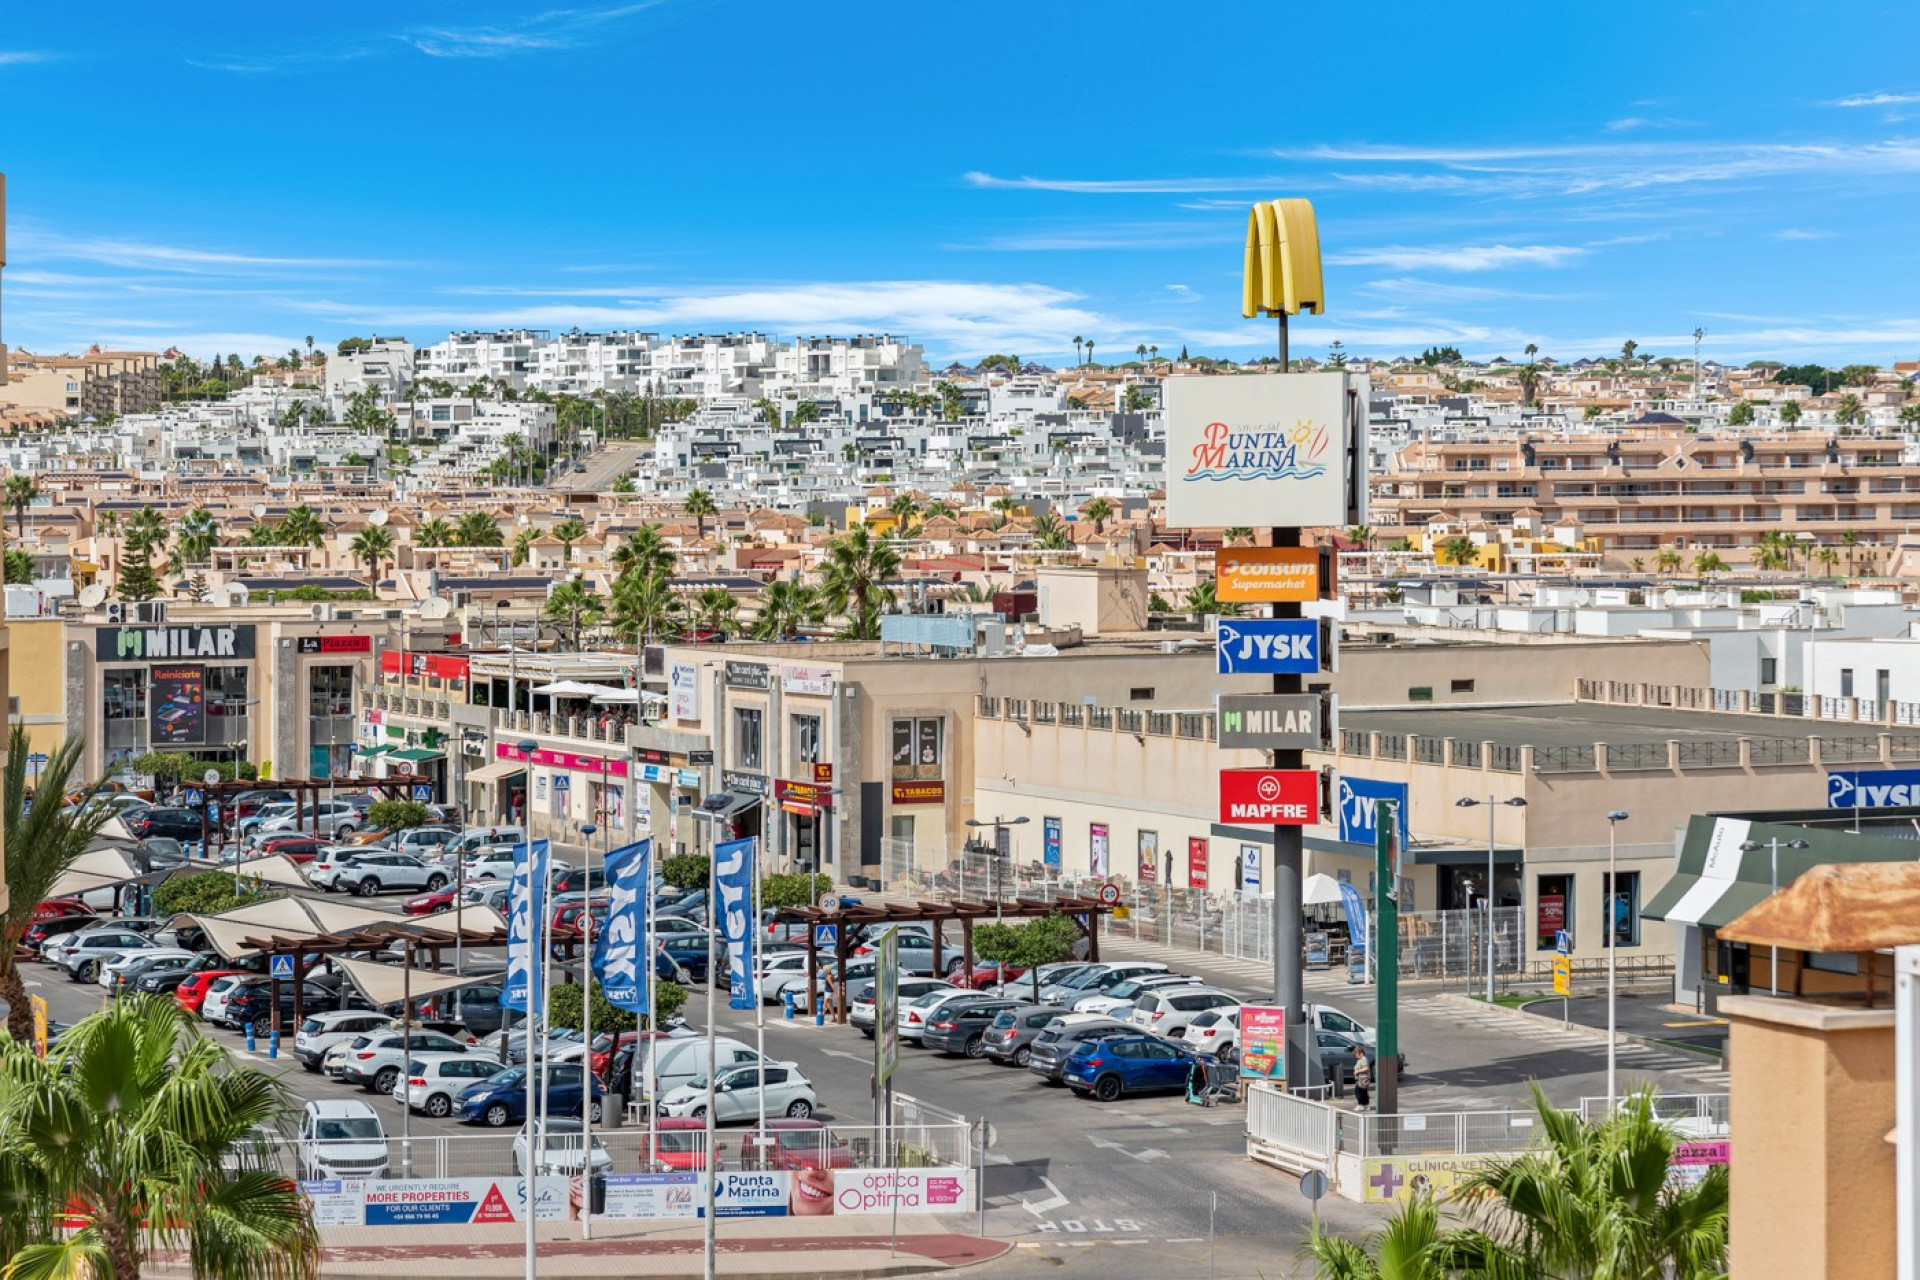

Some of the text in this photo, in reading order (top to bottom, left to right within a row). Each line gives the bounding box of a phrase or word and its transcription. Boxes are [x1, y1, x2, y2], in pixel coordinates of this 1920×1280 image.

[1204, 422, 1287, 450] PUNTA
[1188, 443, 1297, 474] MARINA
[1239, 562, 1316, 577] consum
[1231, 578, 1306, 592] Supermarket
[146, 628, 236, 657] MILAR
[303, 638, 318, 648] La
[1237, 635, 1314, 660] JYSK
[1246, 709, 1312, 734] MILAR
[904, 787, 943, 796] TABACOS
[1230, 803, 1308, 819] MAPFRE
[1708, 827, 1725, 869] McAuto
[823, 899, 836, 908] 20
[1409, 1159, 1458, 1173] CLÍNICA
[375, 1182, 460, 1192] WE URGENTLY REQUIRE
[728, 1175, 773, 1187] Punta
[863, 1173, 919, 1191] óptica
[366, 1191, 470, 1203] MORE PROPERTIES
[516, 1180, 552, 1206] Syle
[728, 1186, 780, 1198] Marina
[838, 1188, 919, 1211] Optima
[385, 1203, 451, 1213] FOR OUR CLIENTS
[1036, 1218, 1142, 1233] STOP
